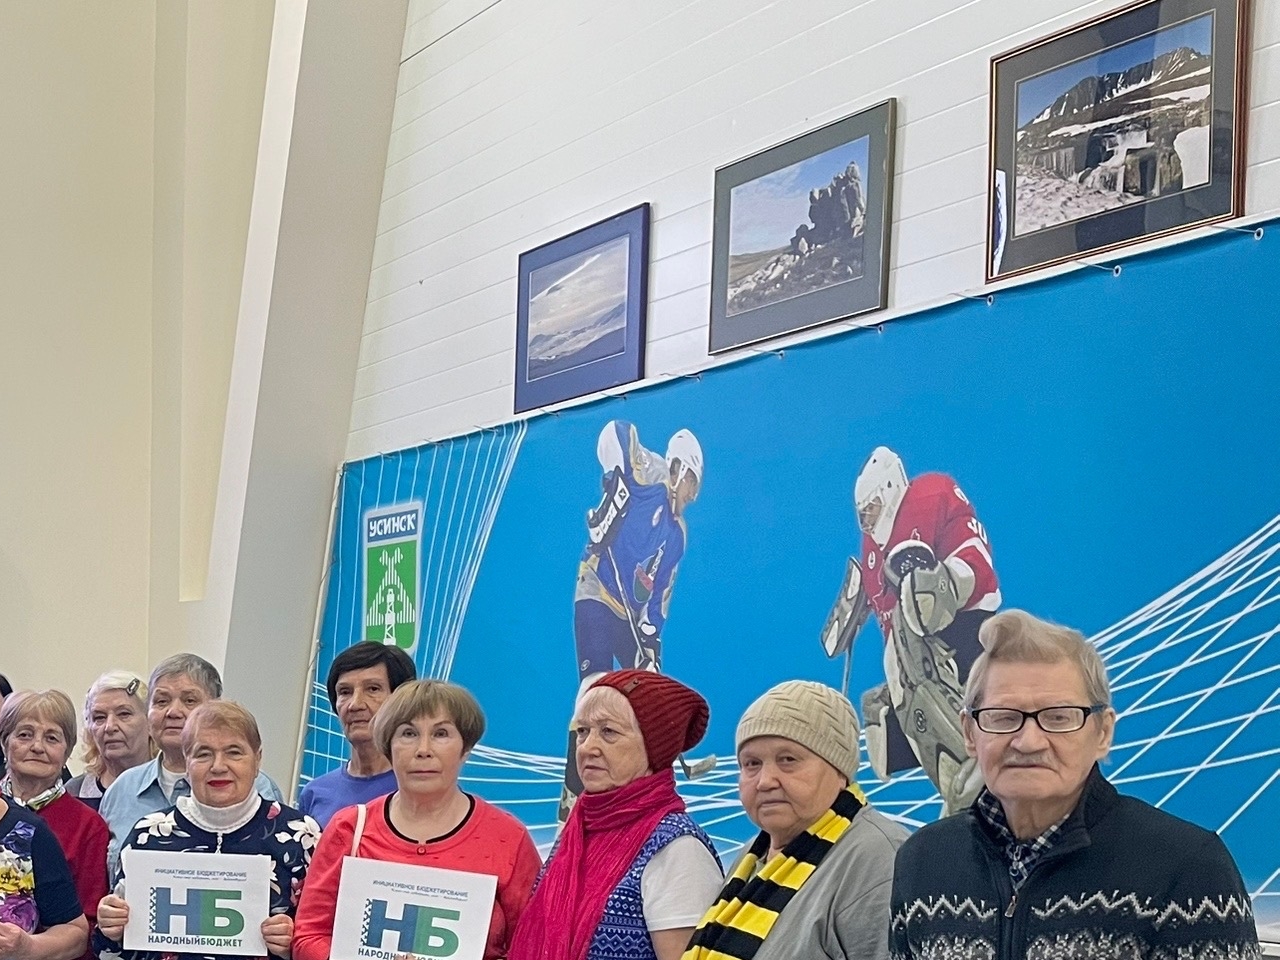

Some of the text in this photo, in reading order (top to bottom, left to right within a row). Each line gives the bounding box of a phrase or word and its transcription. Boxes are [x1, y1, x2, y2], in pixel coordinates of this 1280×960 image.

[369, 513, 416, 537] УСИНСК
[155, 887, 245, 937] НБ
[366, 899, 461, 957] НБ
